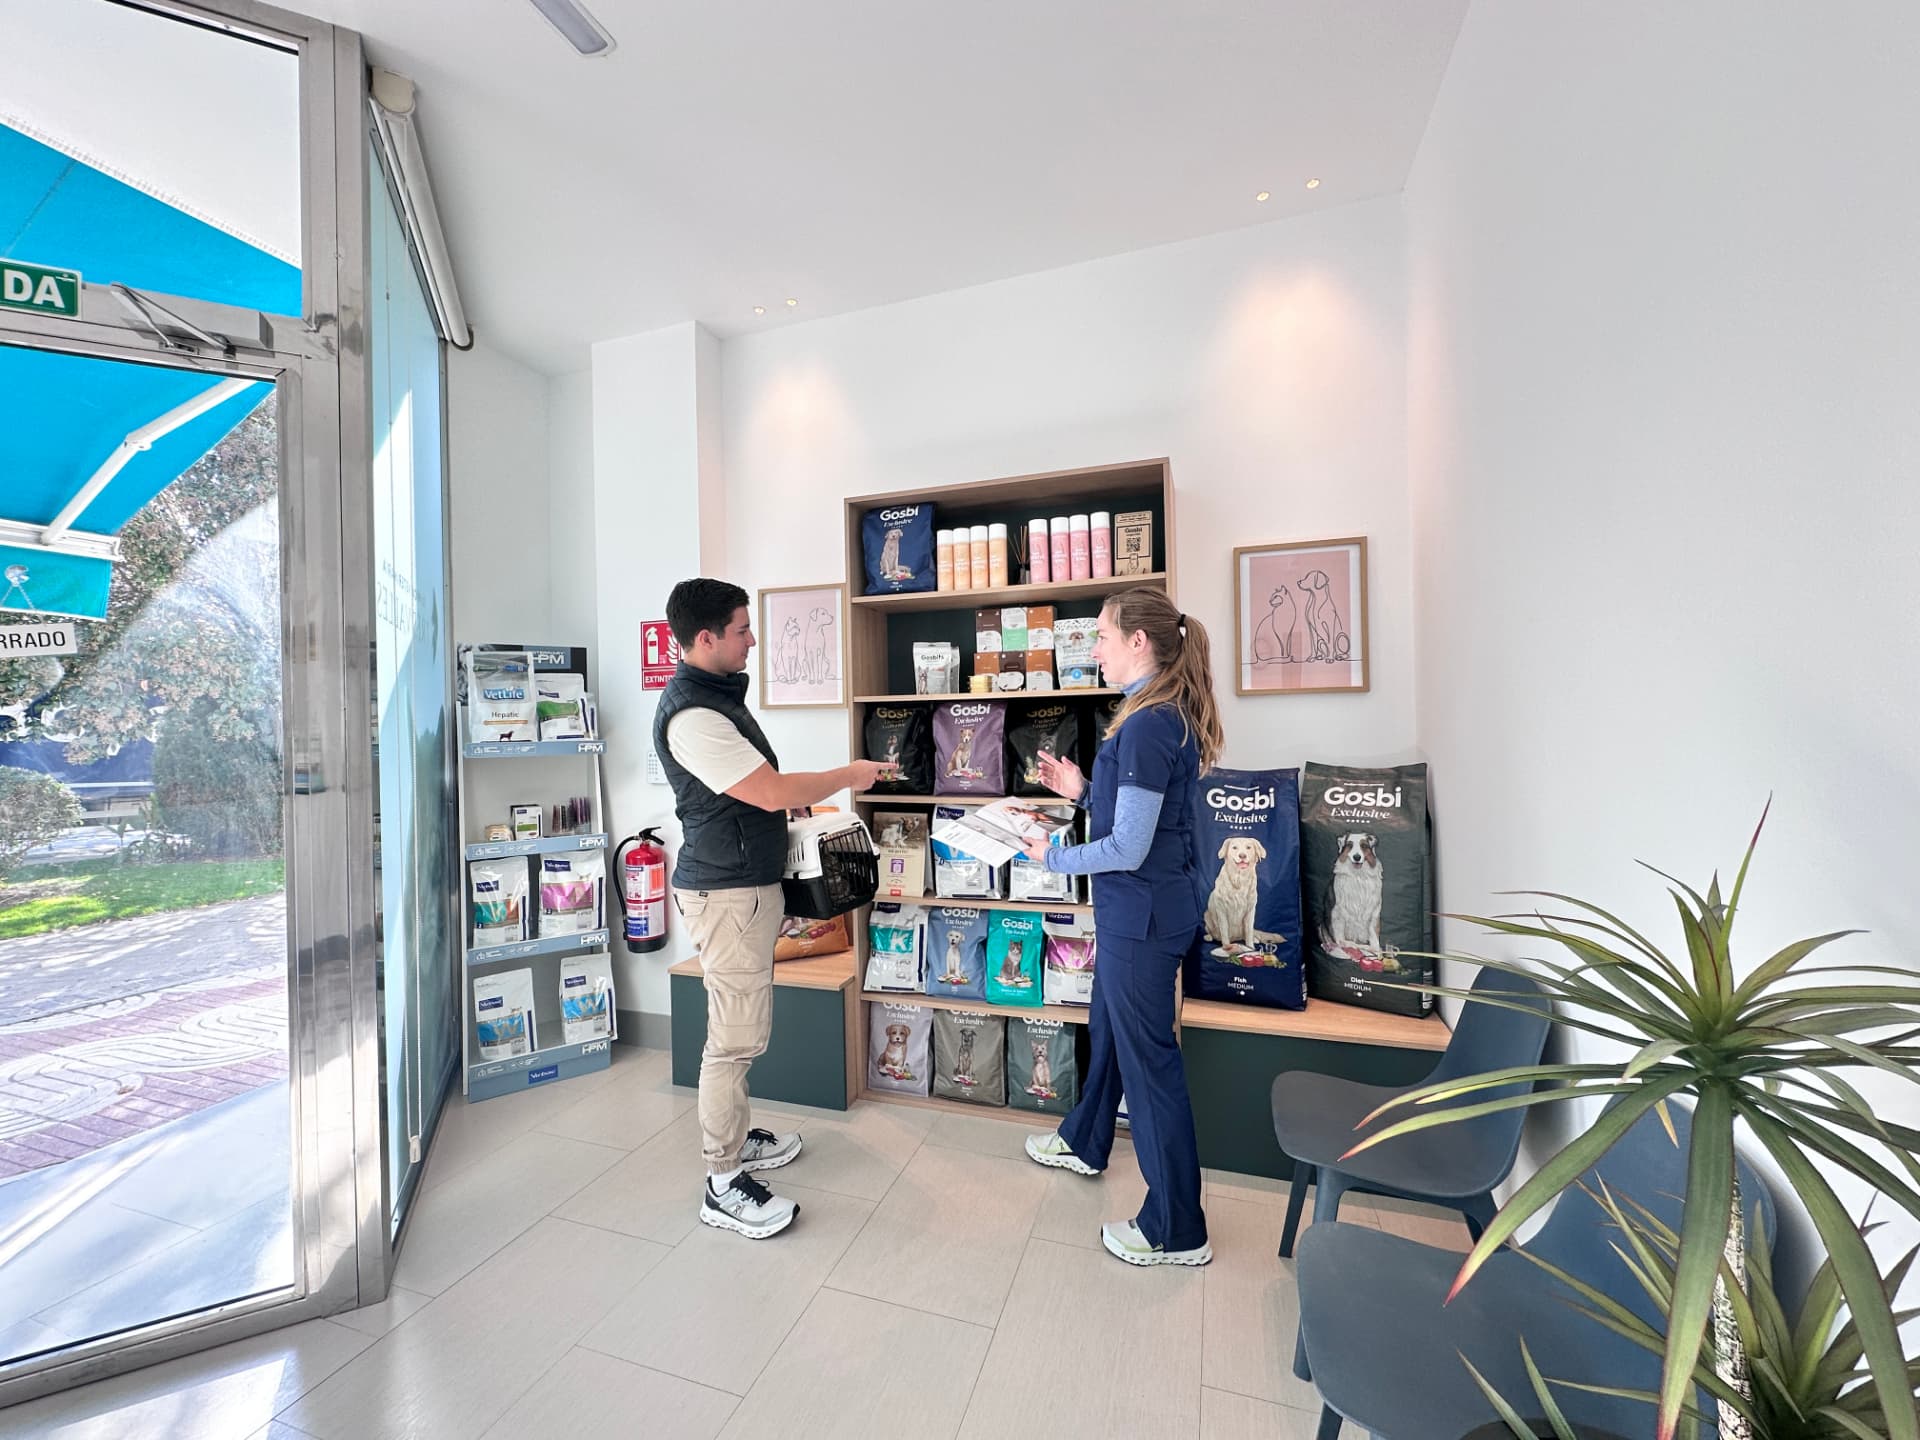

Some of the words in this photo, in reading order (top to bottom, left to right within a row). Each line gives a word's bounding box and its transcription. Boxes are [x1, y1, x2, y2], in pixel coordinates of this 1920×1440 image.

[4, 268, 65, 309] DA
[880, 505, 919, 521] Gosbi
[950, 703, 991, 717] Gosbi
[1206, 787, 1275, 812] Gosbi
[1324, 786, 1402, 808] Gosbi
[1214, 811, 1268, 824] Exclusive
[1330, 807, 1391, 819] Exclusive
[941, 907, 980, 919] Gosbi
[1001, 917, 1033, 931] Gosbi
[1227, 982, 1254, 991] MEDIUM
[1344, 982, 1372, 992] MEDIUM
